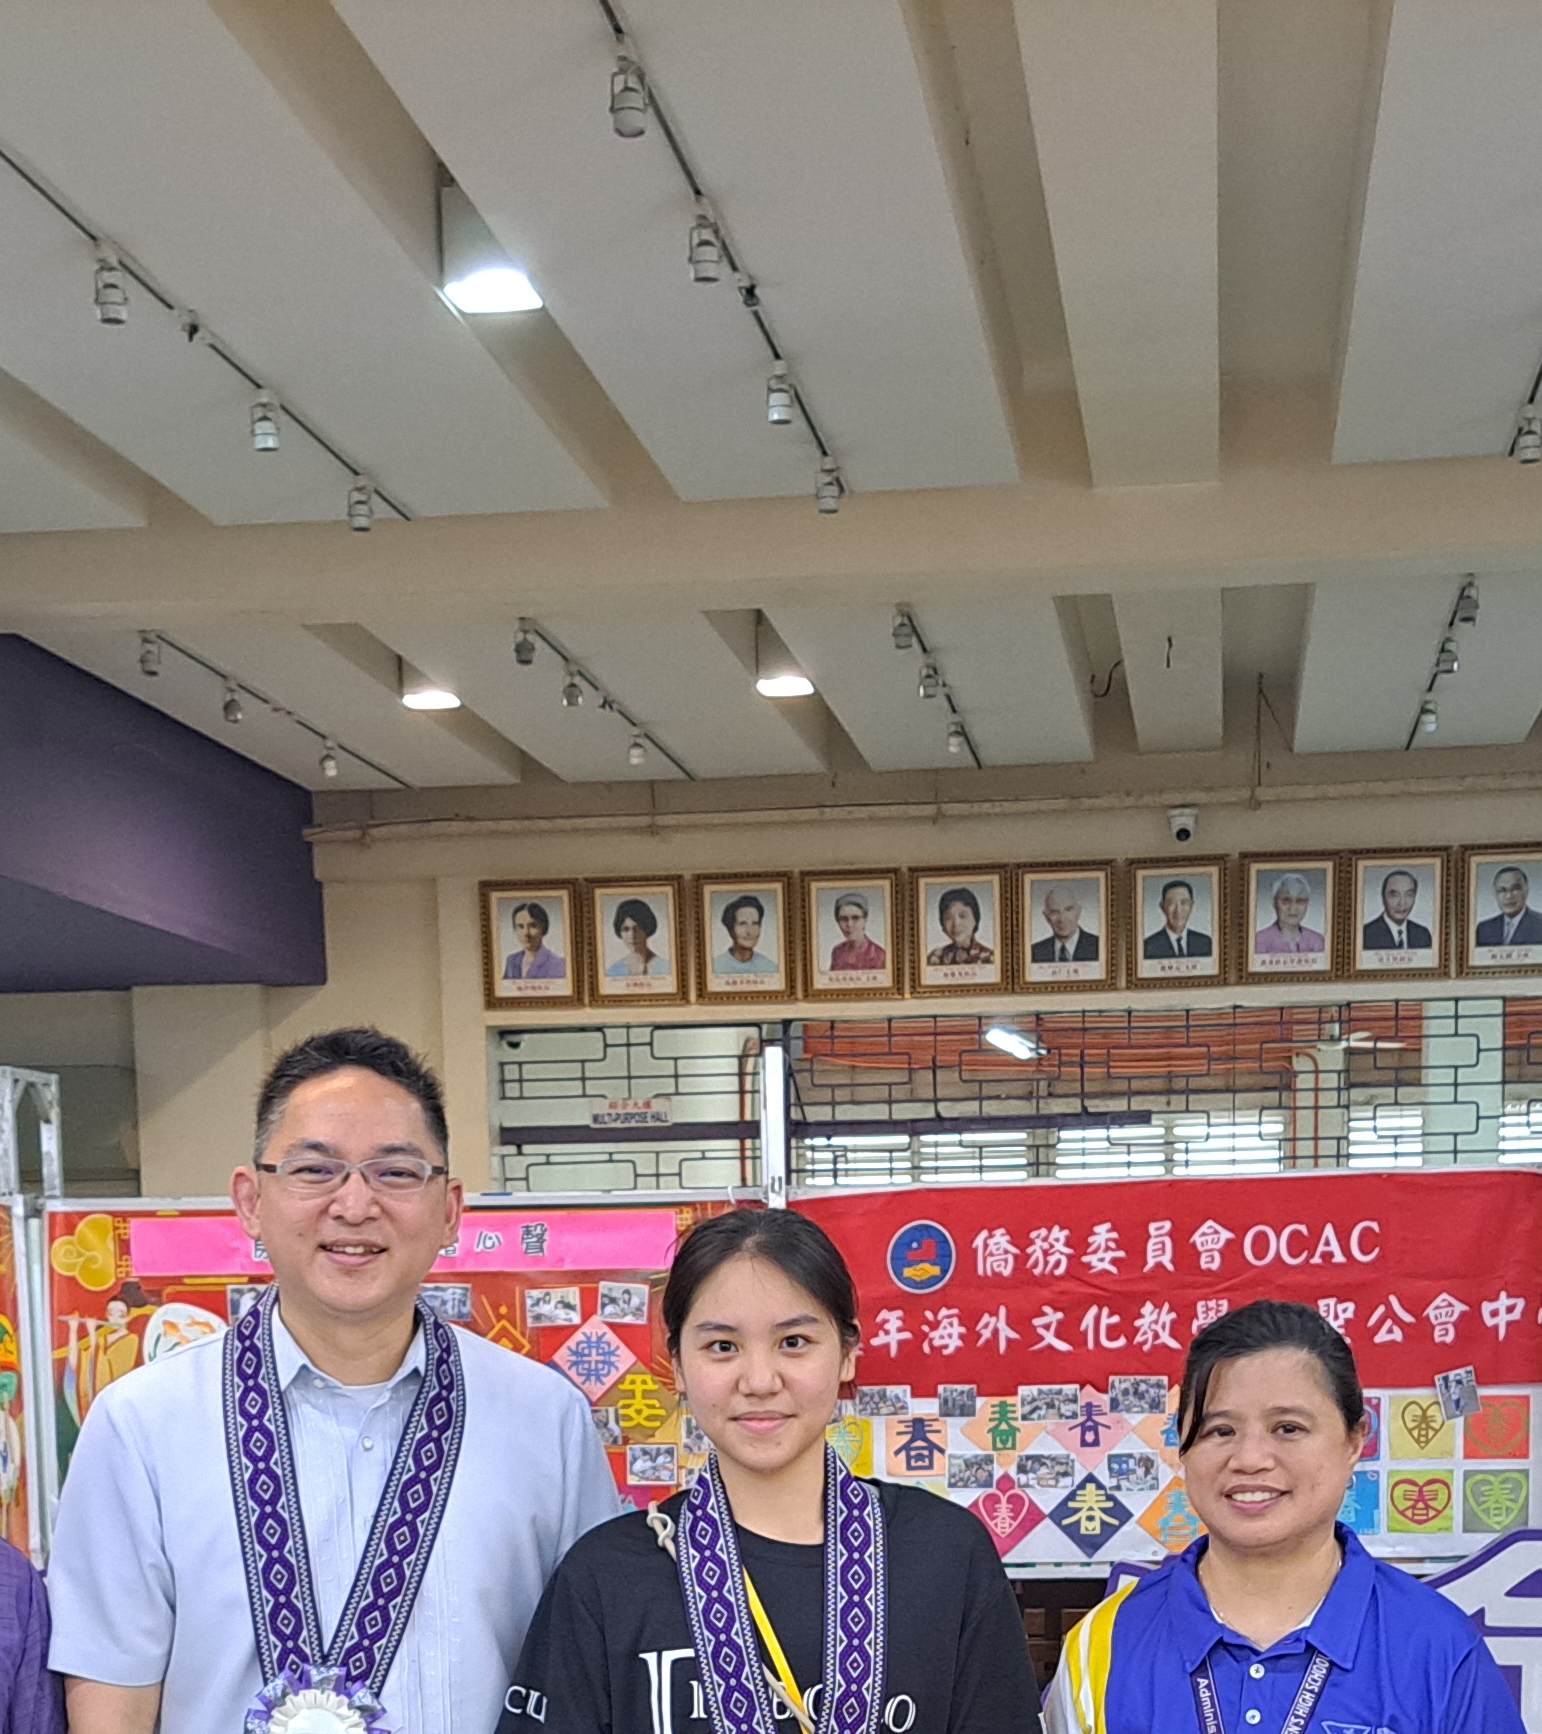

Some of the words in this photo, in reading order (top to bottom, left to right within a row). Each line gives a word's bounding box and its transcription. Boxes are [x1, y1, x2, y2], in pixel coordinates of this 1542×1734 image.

[894, 1417, 946, 1472] 春
[987, 1400, 1022, 1451] 春
[1067, 1401, 1112, 1448] 春
[1061, 1482, 1120, 1535] 春
[1293, 1690, 1315, 1718] HIGH
